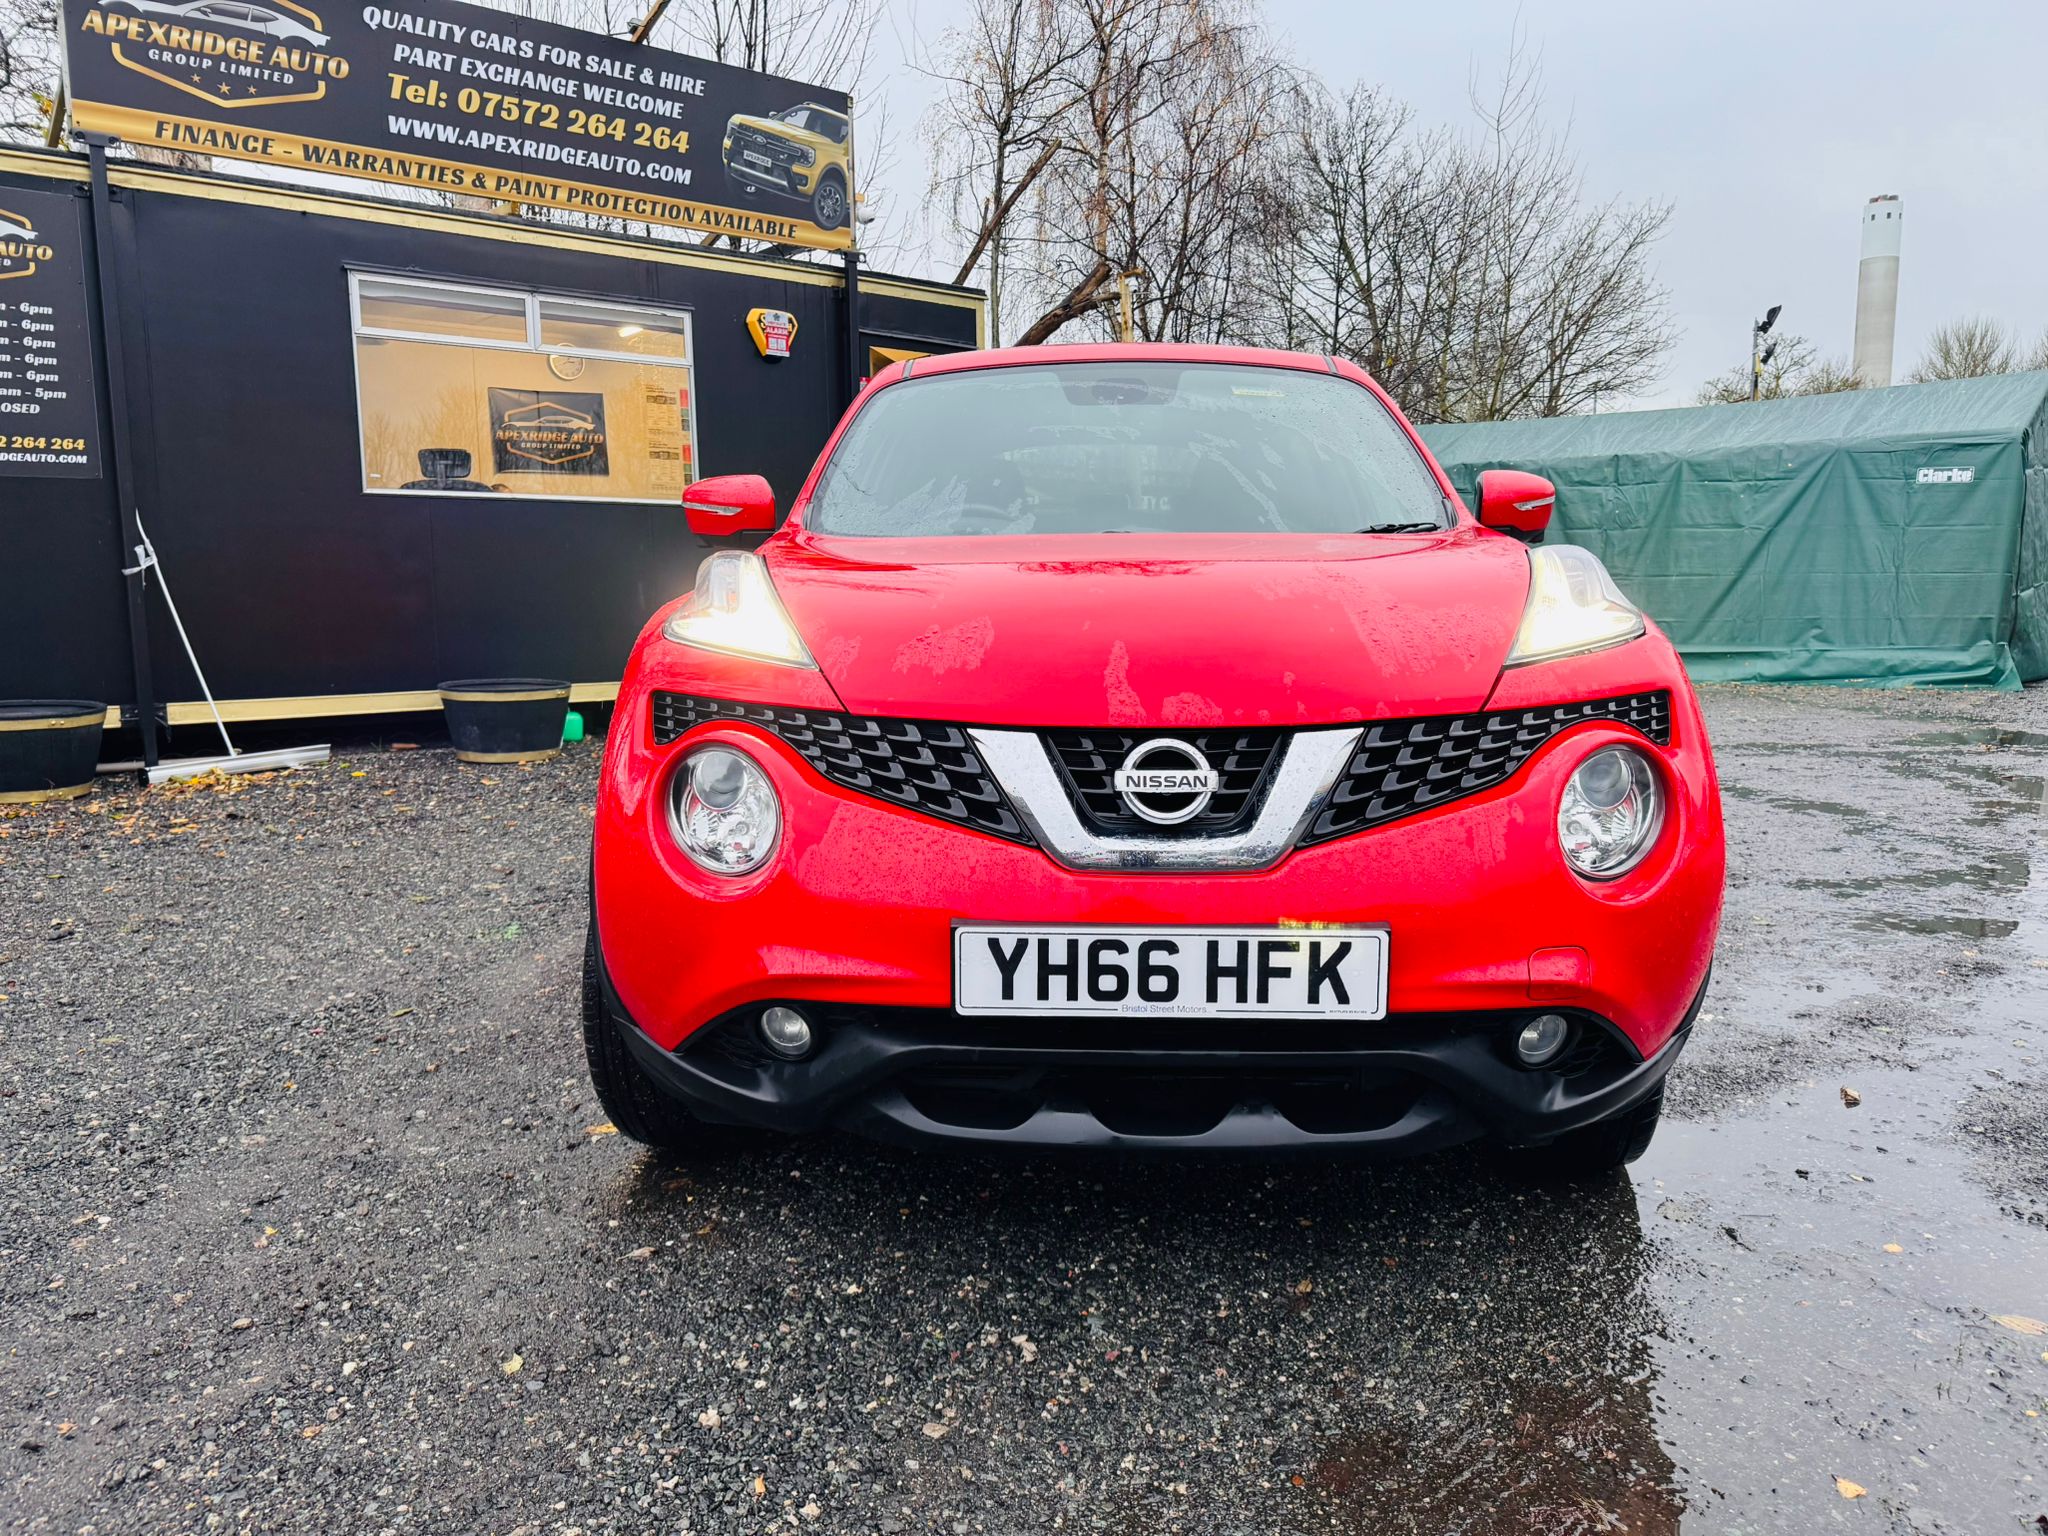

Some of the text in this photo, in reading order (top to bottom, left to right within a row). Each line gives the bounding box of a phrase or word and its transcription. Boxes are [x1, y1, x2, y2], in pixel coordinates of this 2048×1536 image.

[81, 9, 350, 80] APEXRIDGE AUTO
[362, 6, 707, 96] QUALITY CARS FOR SALE & HIRE
[148, 48, 294, 85] GROUP LIMITED
[393, 43, 684, 119] PART EXCHANGE WELCOME
[388, 73, 689, 154] Tel: 07572 264 264
[388, 115, 692, 185] WWW.APEXRIDGEAUTO.COM
[155, 120, 277, 155] FINANCE
[302, 143, 465, 186] WARRANTIES
[471, 172, 488, 190] &
[495, 177, 562, 204] PAINT
[566, 188, 695, 222] PROTECTION
[699, 209, 798, 239] AVAILABLE
[20, 302, 53, 315] 6pm
[21, 319, 54, 332] 6pm
[23, 336, 56, 349] 6pm
[24, 353, 57, 366] 6pm
[26, 370, 59, 383] 6pm
[34, 387, 67, 400] 5pm
[0, 402, 40, 414] OSED
[11, 436, 47, 449] 264
[50, 438, 85, 450] 264
[496, 429, 604, 444] APEXRIDGE AUTO
[1918, 468, 1972, 483] Clarke
[1126, 775, 1208, 788] NISSAN
[987, 937, 1352, 1005] YH66 HFK
[1121, 1004, 1148, 1013] Bristol
[1150, 1004, 1175, 1013] Street
